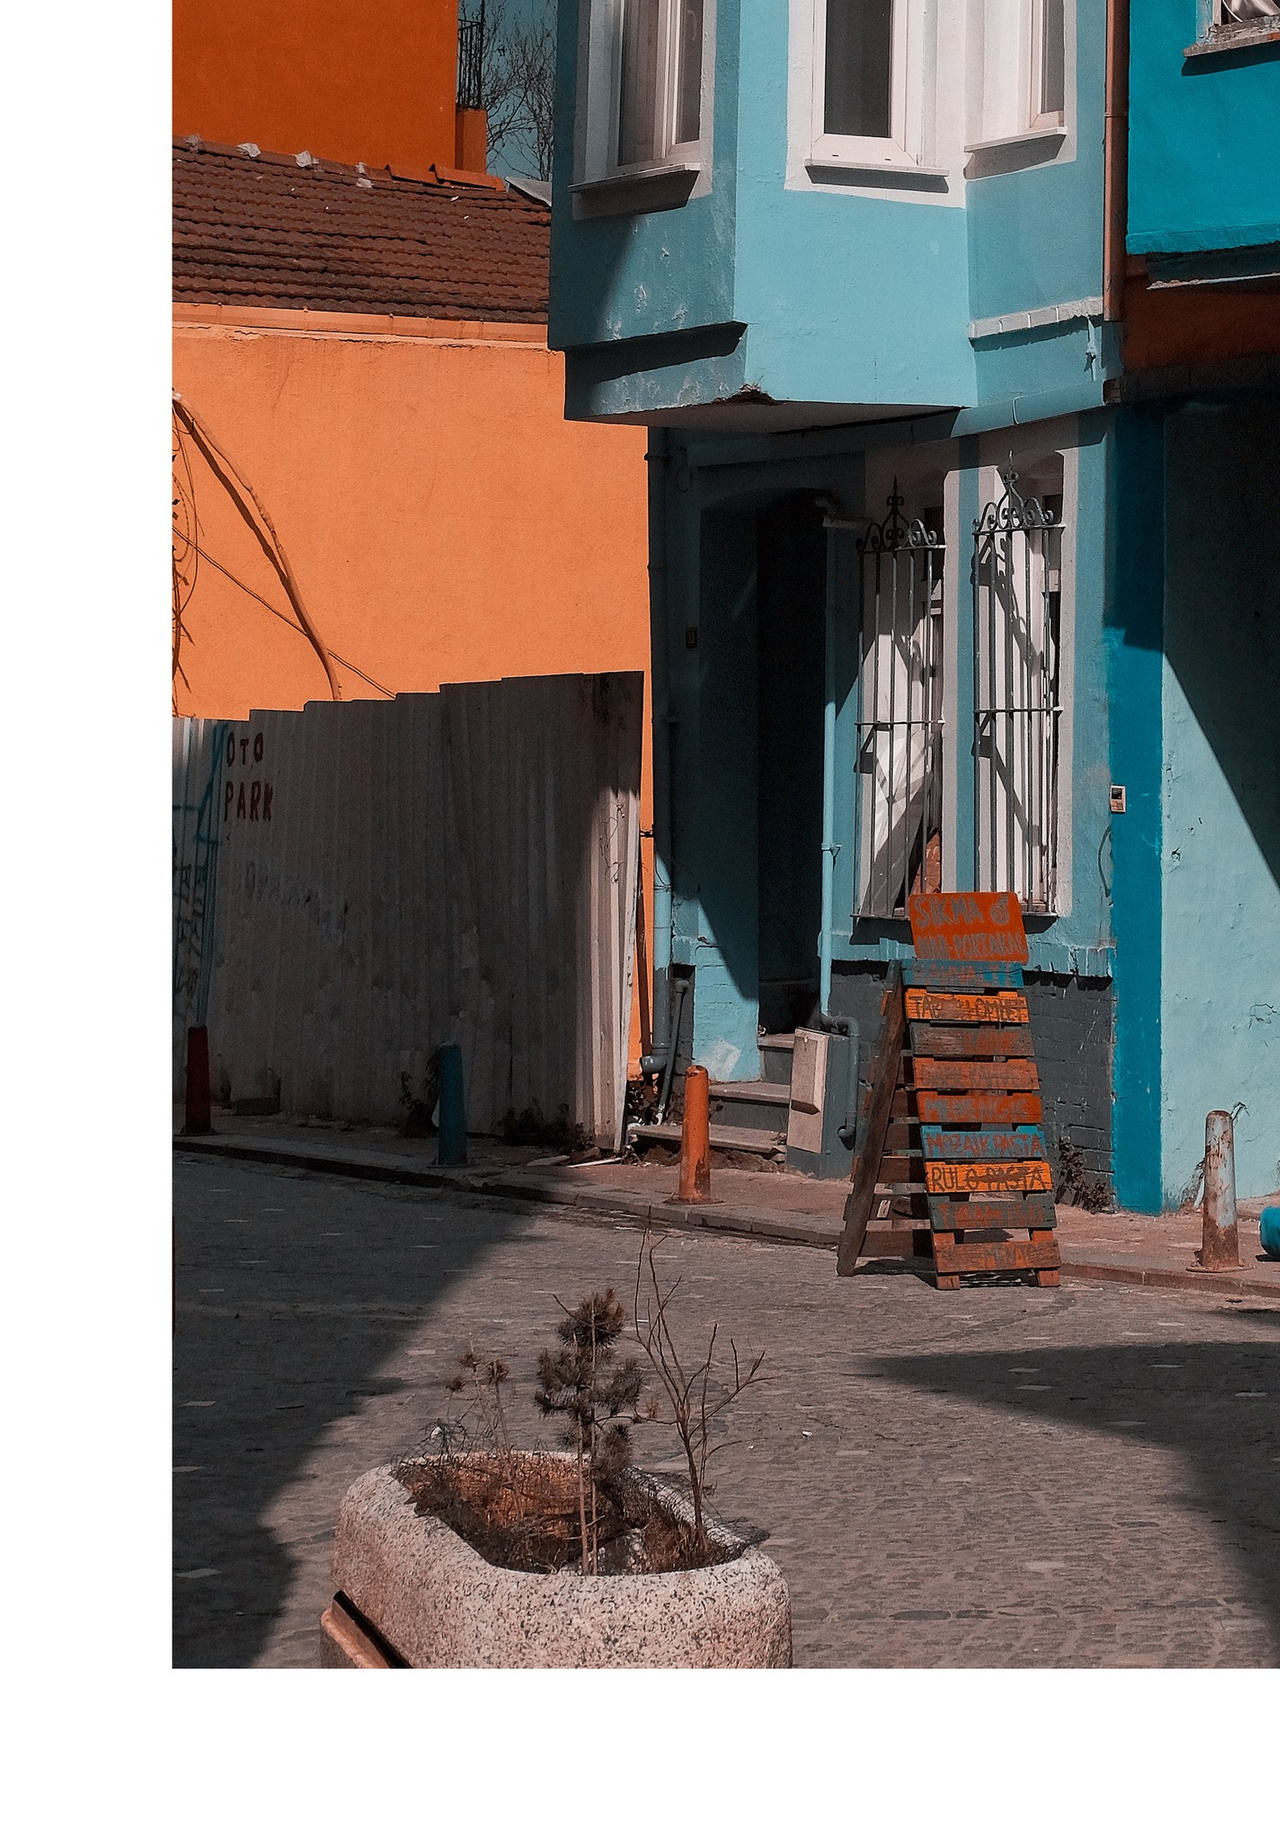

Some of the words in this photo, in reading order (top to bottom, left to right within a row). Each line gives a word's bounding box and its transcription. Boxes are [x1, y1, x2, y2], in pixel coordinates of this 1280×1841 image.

[226, 731, 264, 768] OTO
[224, 780, 274, 822] PARK
[992, 1132, 1045, 1158] PASTA
[931, 1166, 980, 1192] RULO
[985, 1166, 1046, 1191] PASTA
